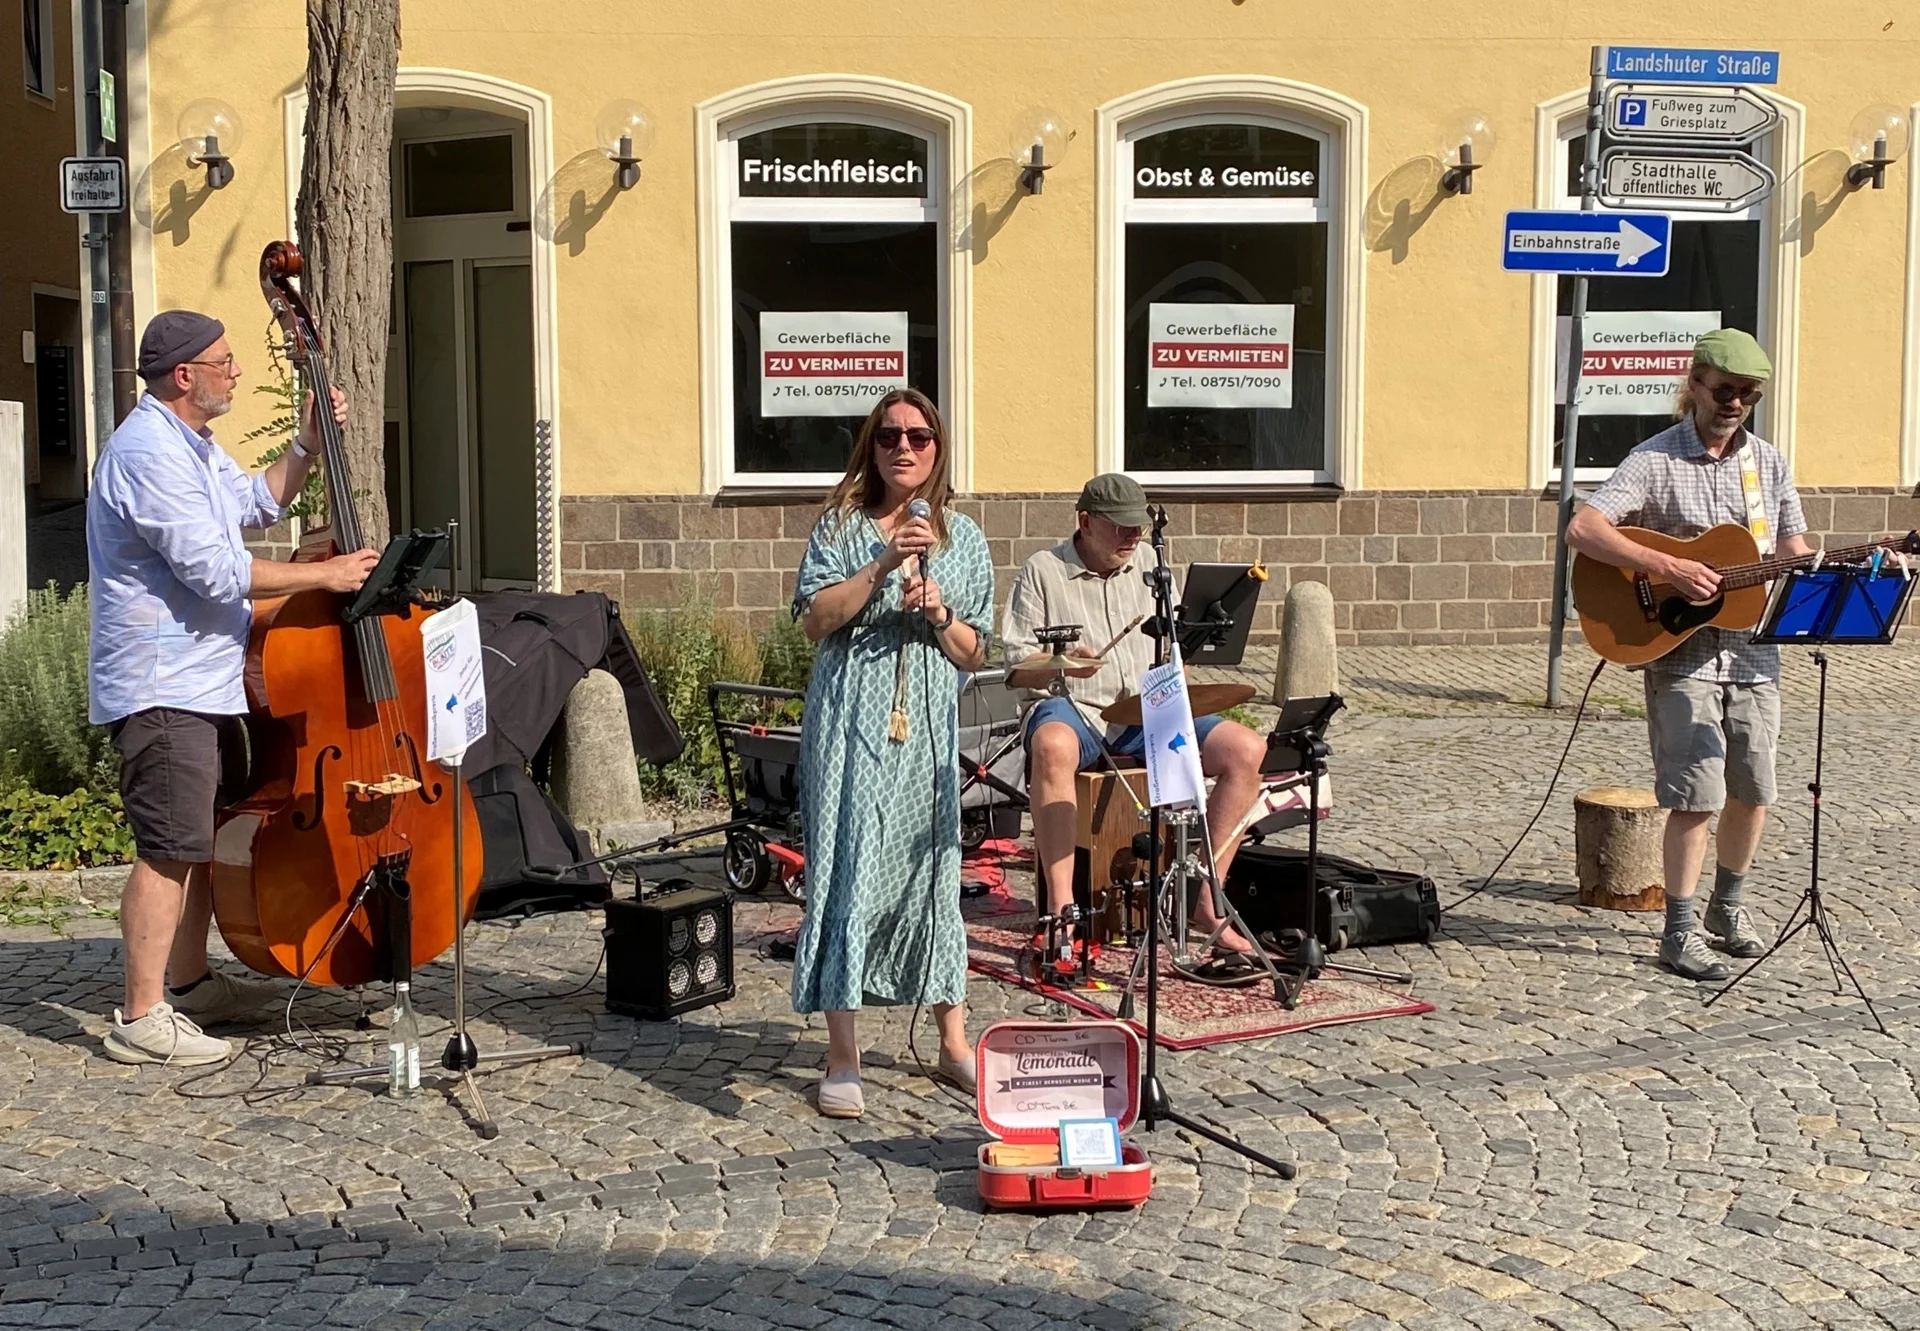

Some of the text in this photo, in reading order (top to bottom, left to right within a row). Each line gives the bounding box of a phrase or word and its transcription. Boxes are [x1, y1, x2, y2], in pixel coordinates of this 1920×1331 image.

[1615, 51, 1771, 75] Landshuter Straße
[1625, 102, 1641, 122] P
[1651, 99, 1736, 114] Fußweg zum
[1660, 115, 1728, 130] Griesplatz
[71, 168, 116, 181] Ausfahrt
[743, 157, 923, 183] Frischfleisch
[1136, 166, 1315, 187] Obst & Gemüse
[1631, 162, 1717, 180] Stadthalle
[1622, 178, 1723, 196] öffentliches WC
[1512, 234, 1621, 250] Einbahnstraße
[1166, 324, 1278, 336] Gewerbefläche
[777, 332, 891, 344] Gewerbefläche
[1157, 349, 1284, 363] ZU VERMIETEN
[1583, 356, 1693, 370] ZU VERMIETE
[769, 357, 899, 371] ZU VERMIETEN
[1171, 375, 1281, 389] Tel. 08751/7090
[784, 385, 810, 397] Tel.
[1596, 384, 1622, 396] Tel.
[1014, 1034, 1036, 1045] CD
[1014, 1048, 1096, 1075] Lemonade
[1044, 1078, 1072, 1086] ACOUSTIC
[1016, 1101, 1036, 1112] CD
